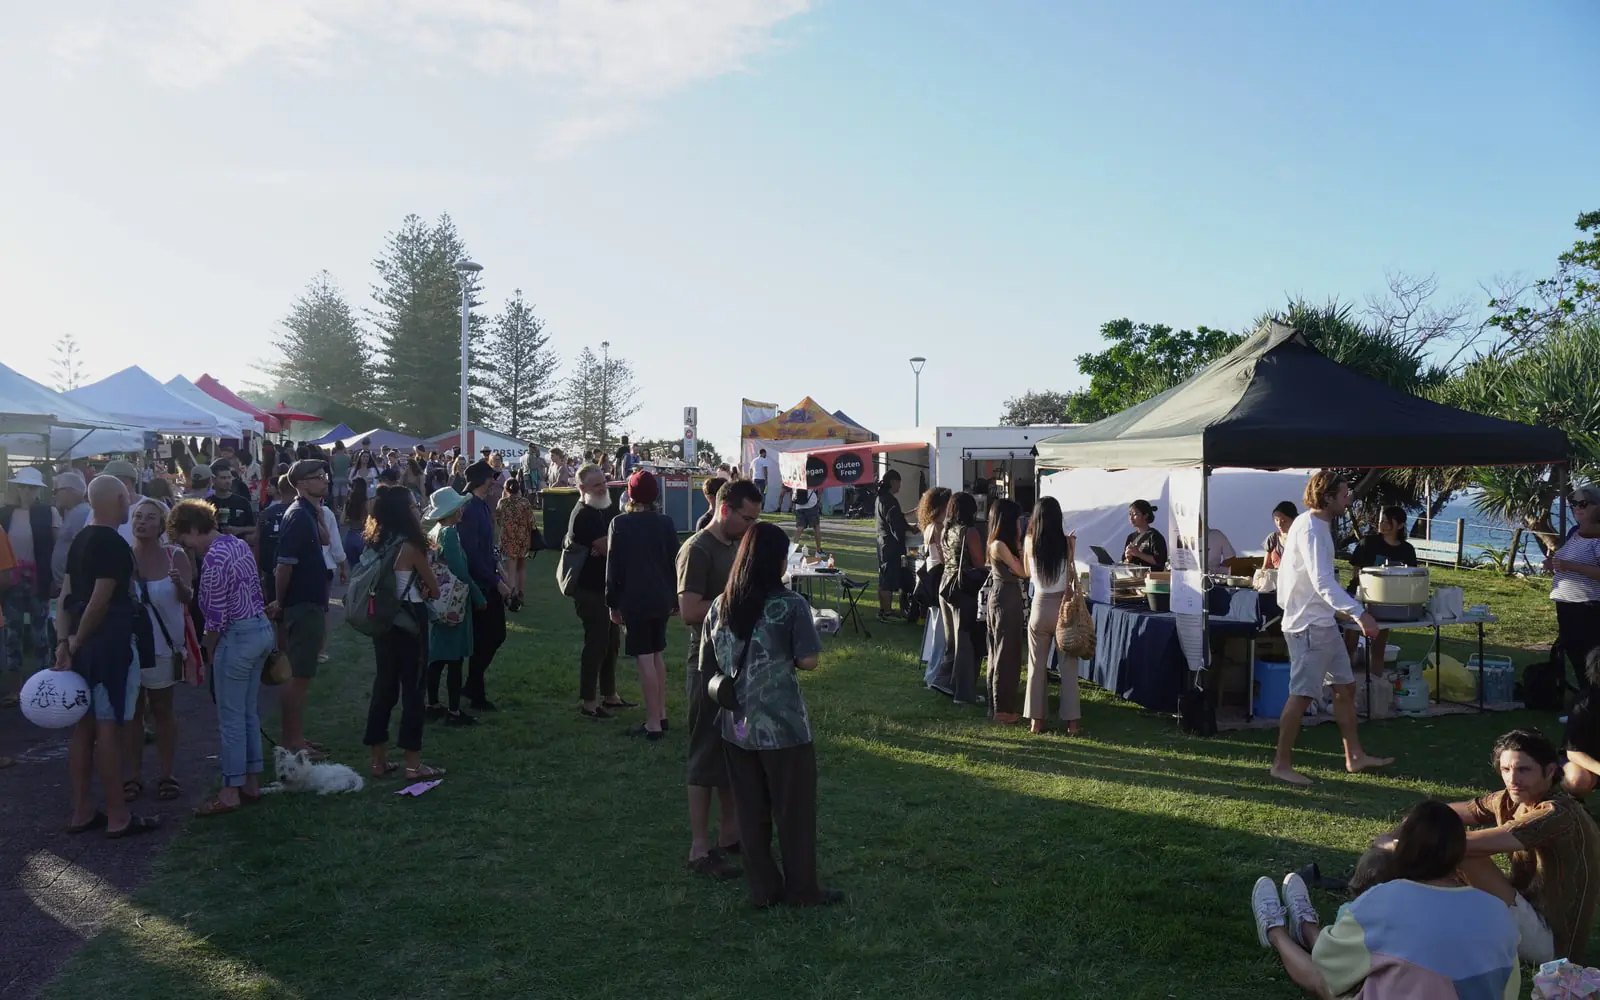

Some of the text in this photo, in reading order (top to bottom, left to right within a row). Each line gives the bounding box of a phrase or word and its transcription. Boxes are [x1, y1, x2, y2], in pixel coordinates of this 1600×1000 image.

[835, 461, 860, 470] Gluten
[806, 468, 824, 476] egan
[840, 469, 857, 477] Free
